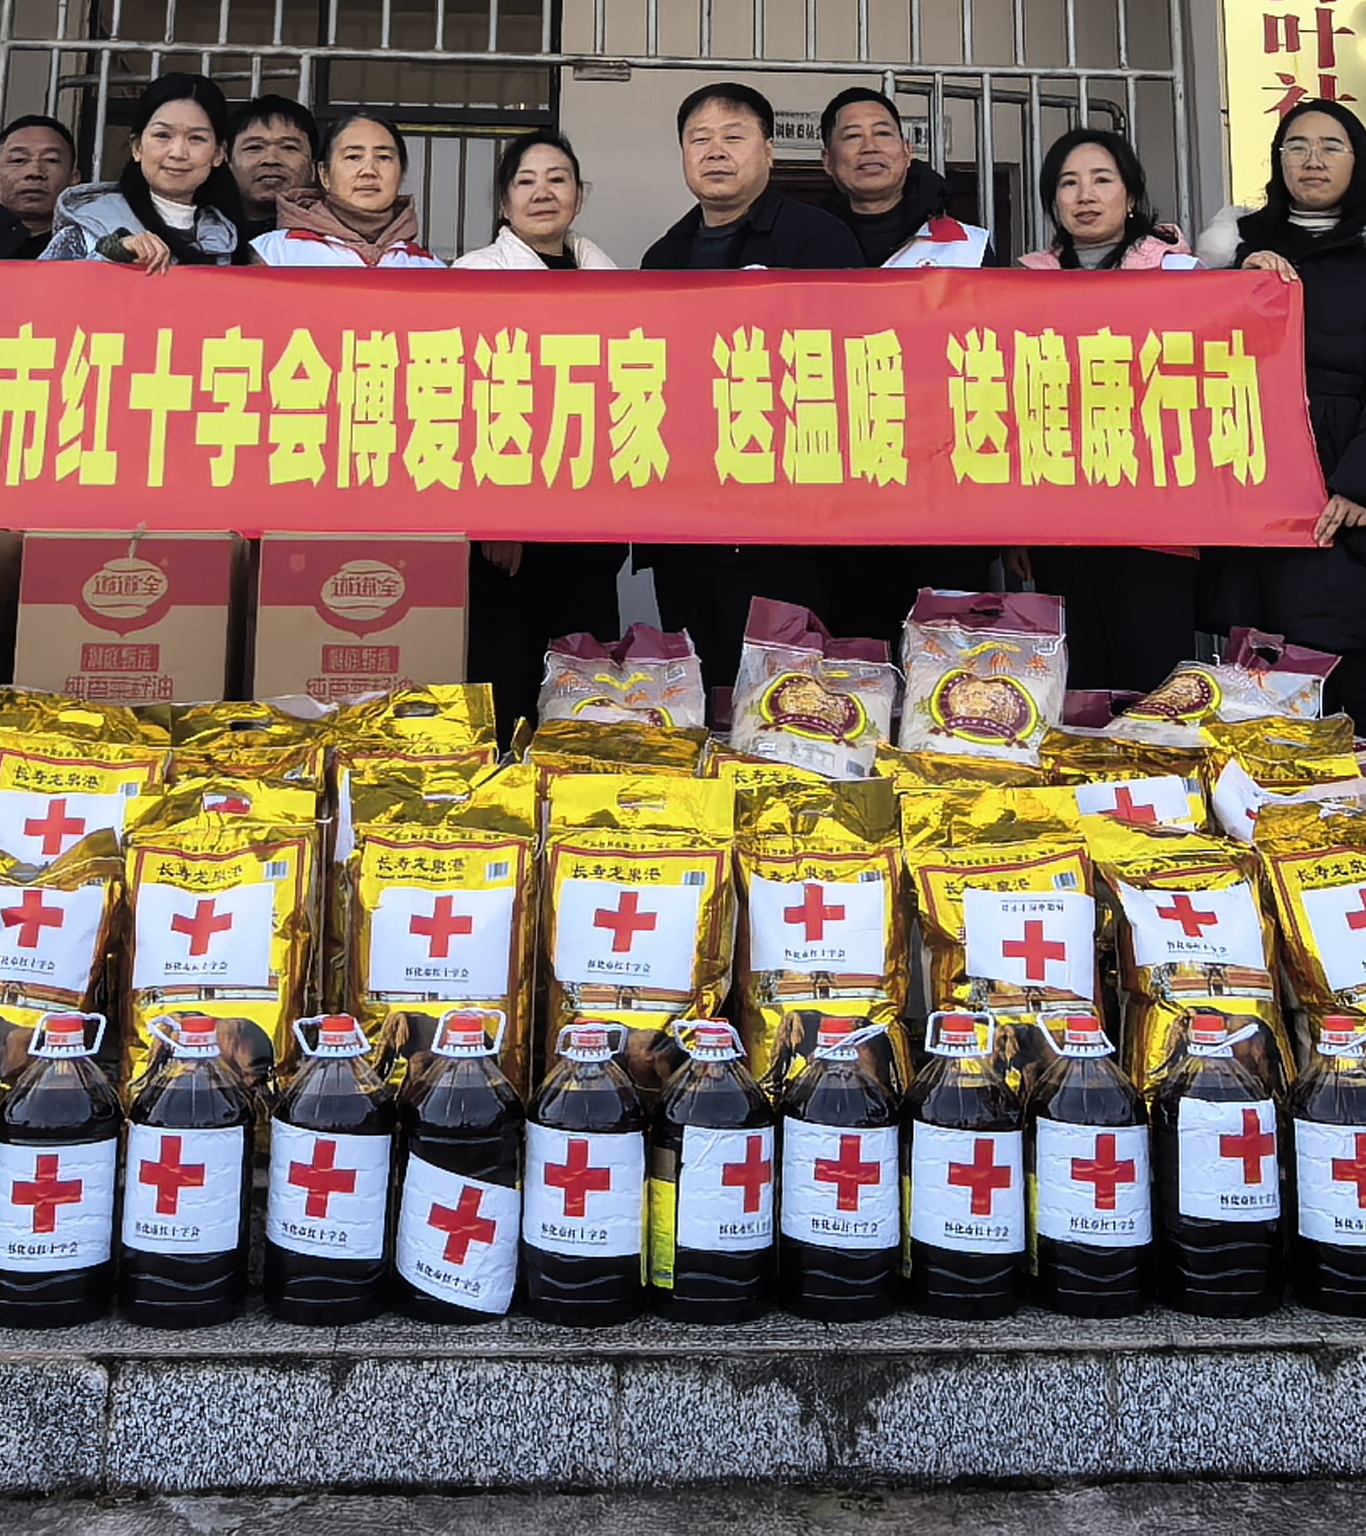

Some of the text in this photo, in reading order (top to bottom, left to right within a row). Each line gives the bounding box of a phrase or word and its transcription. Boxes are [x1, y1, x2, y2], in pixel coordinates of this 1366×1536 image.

[713, 325, 908, 485] 送温暖
[947, 325, 1267, 487] 送健康行动
